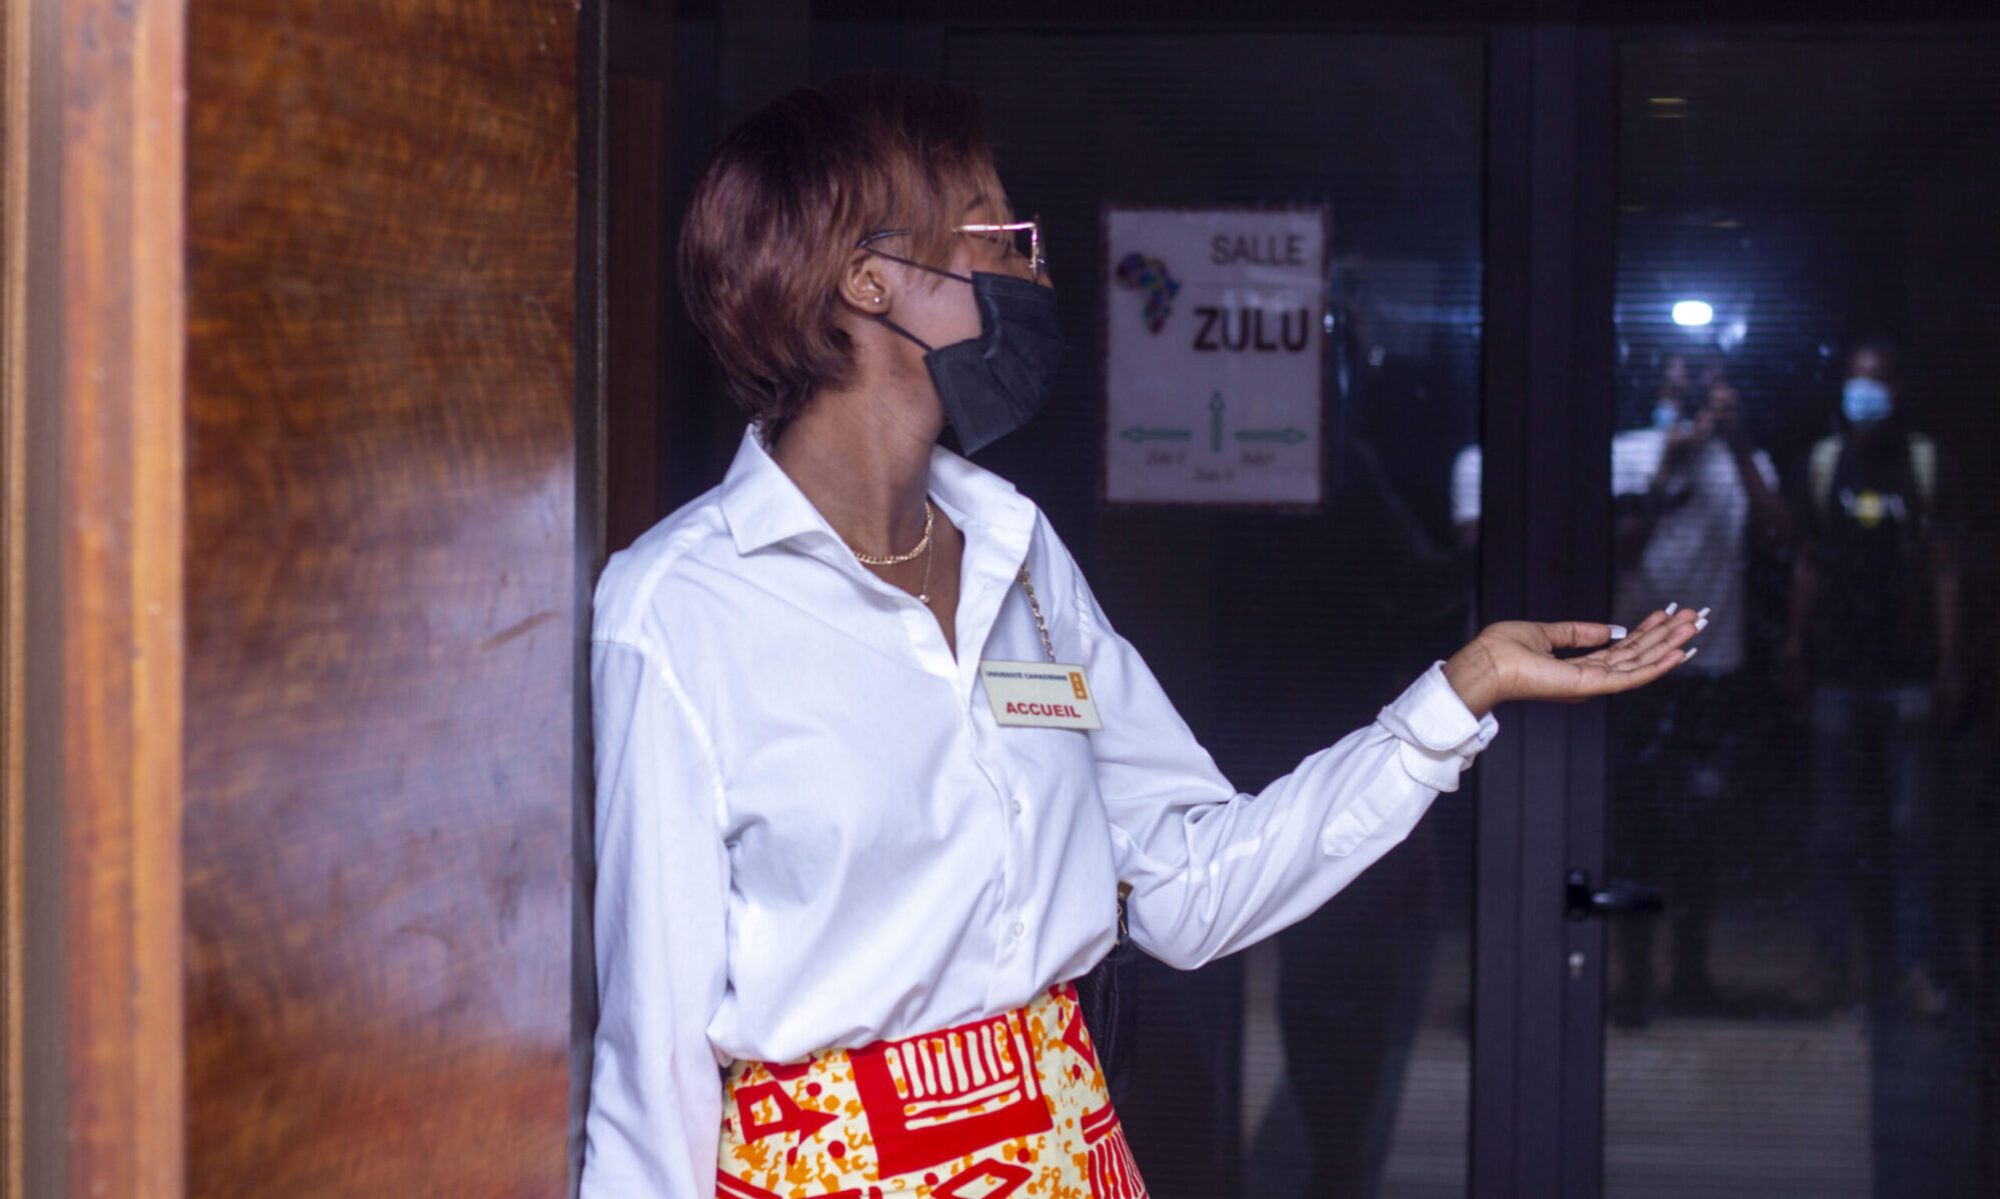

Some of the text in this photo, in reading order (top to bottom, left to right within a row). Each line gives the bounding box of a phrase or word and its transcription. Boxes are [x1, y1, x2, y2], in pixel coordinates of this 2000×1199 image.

[1211, 235, 1304, 266] SALLE
[1193, 307, 1309, 352] ZULU
[1006, 701, 1082, 718] ACCUEIL
